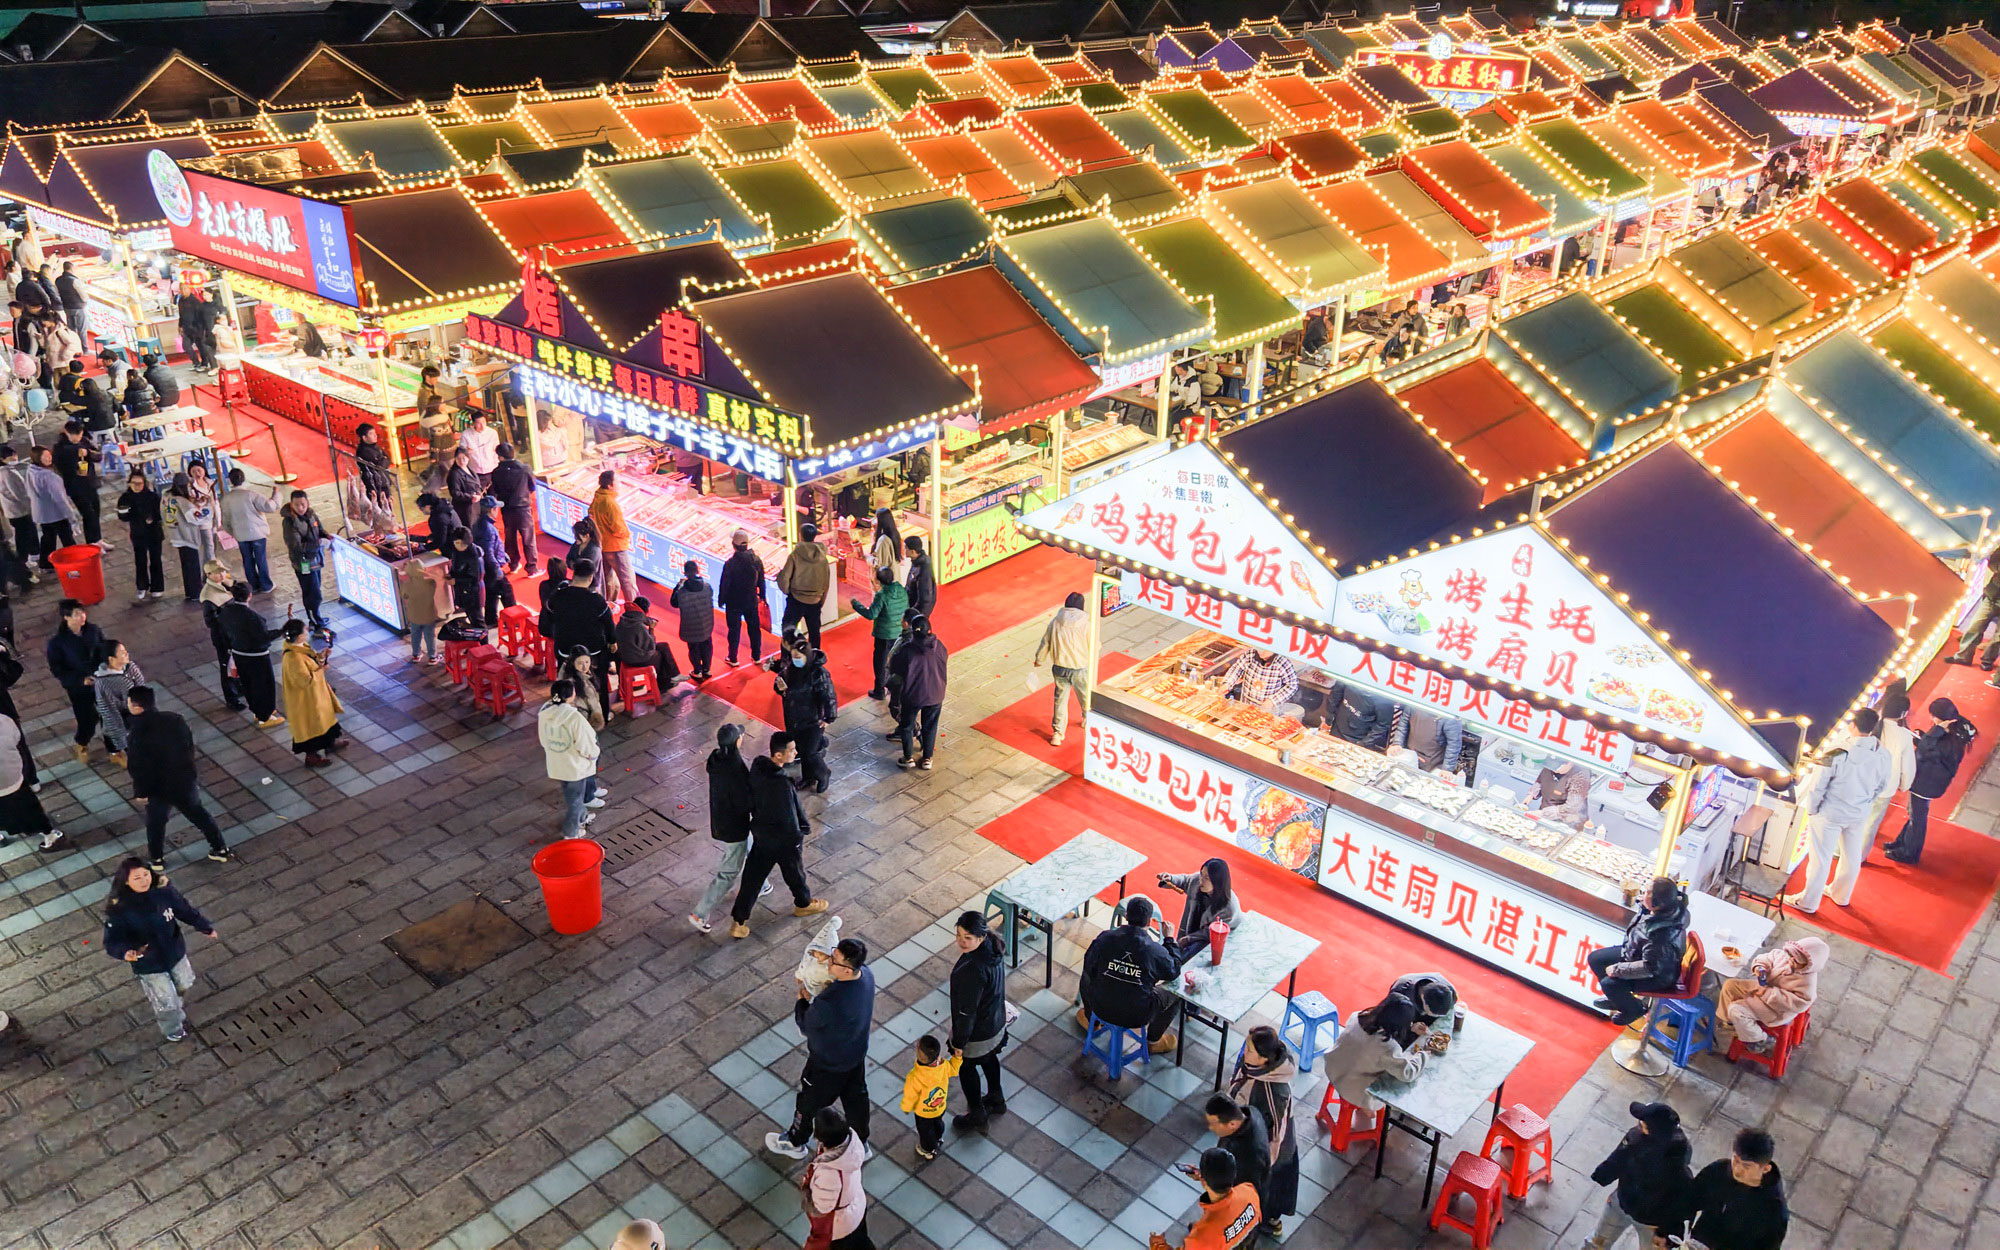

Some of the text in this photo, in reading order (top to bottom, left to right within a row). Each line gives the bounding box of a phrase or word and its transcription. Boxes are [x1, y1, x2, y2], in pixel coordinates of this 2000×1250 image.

[1380, 58, 1501, 88] 北京爆肚
[197, 191, 299, 255] 老北京爆肚
[661, 310, 701, 378] 串
[537, 338, 613, 386] 纯牛纯羊
[614, 363, 699, 415] 每日新鲜
[706, 392, 802, 449] 真材实料
[1161, 485, 1213, 504] 外焦里嫩
[1177, 470, 1229, 488] 每日现做
[1091, 492, 1285, 597] 鸡翅包饭
[1445, 568, 1596, 645] 烤生蚝
[1436, 616, 1579, 695] 烤扇贝
[1089, 726, 1238, 833] 鸡翅包饭
[1327, 831, 1606, 998] 大连扇贝湛江蚝
[1108, 961, 1142, 978] EVOLVE
